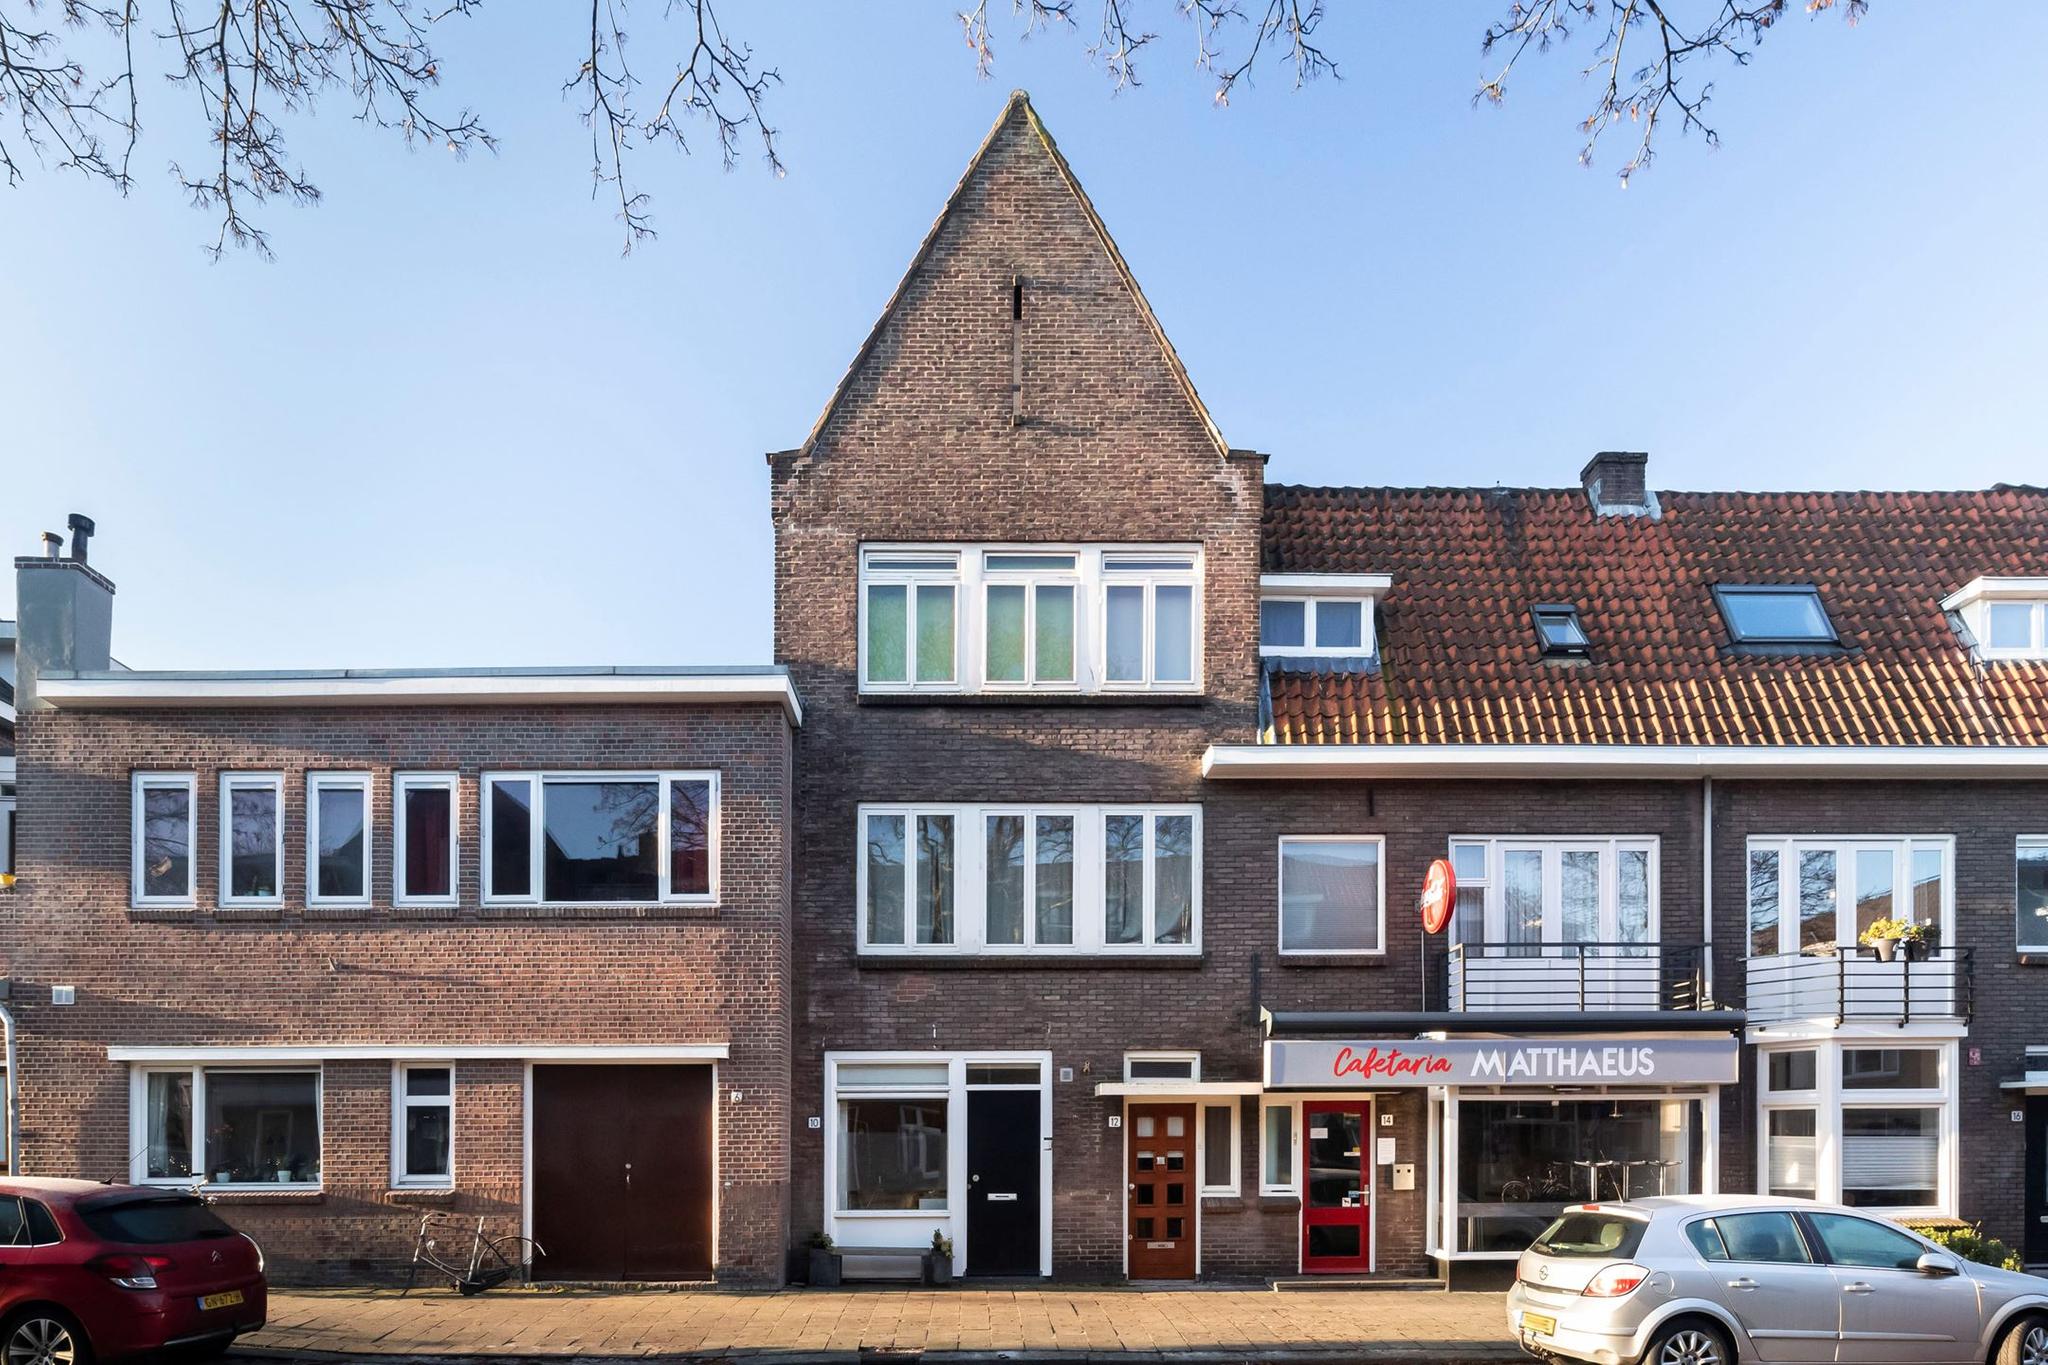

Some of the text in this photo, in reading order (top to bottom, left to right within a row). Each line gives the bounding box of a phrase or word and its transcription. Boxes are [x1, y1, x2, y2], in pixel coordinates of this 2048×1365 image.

[1333, 1047, 1655, 1080] Cafetaria MATTHAEUS
[1383, 1115, 1391, 1124] 14
[2013, 1111, 2022, 1121] 16
[810, 1118, 819, 1127] 10
[1111, 1117, 1119, 1126] 12
